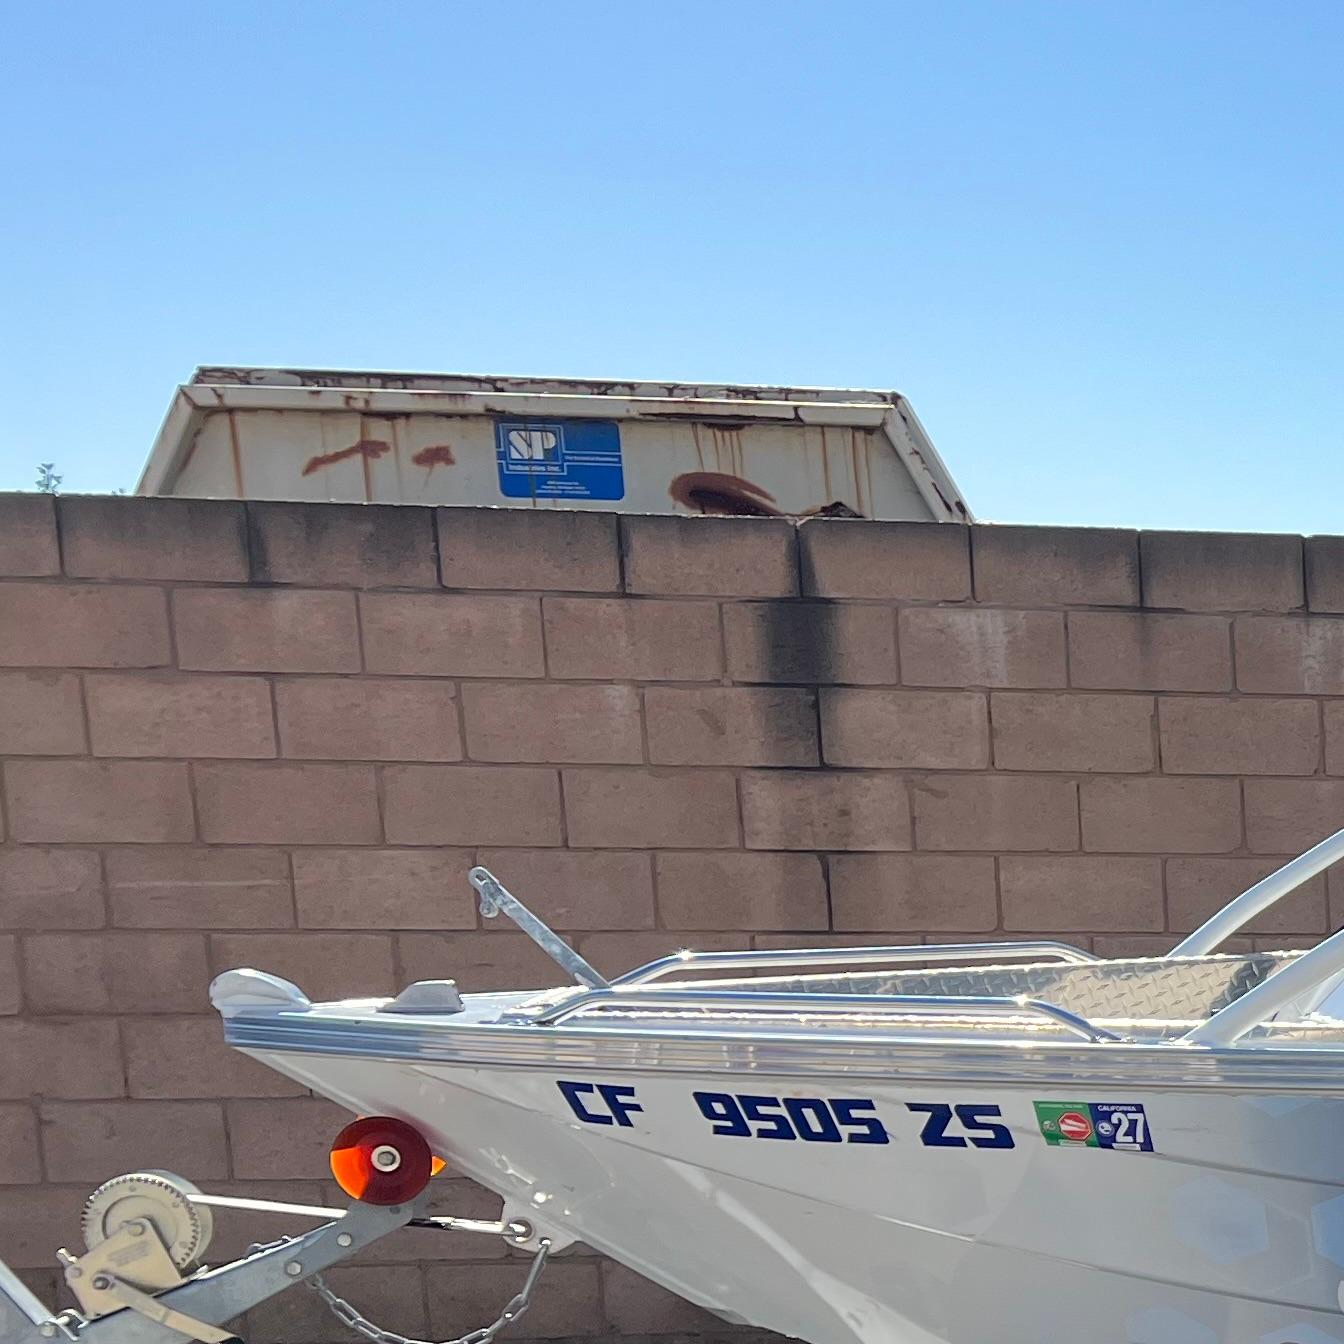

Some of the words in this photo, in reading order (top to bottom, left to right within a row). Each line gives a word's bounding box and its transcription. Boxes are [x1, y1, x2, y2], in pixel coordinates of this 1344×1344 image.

[556, 1080, 645, 1128] CF
[692, 1091, 890, 1144] 9505
[904, 1102, 1015, 1149] ZS
[1110, 1112, 1145, 1143] 27
